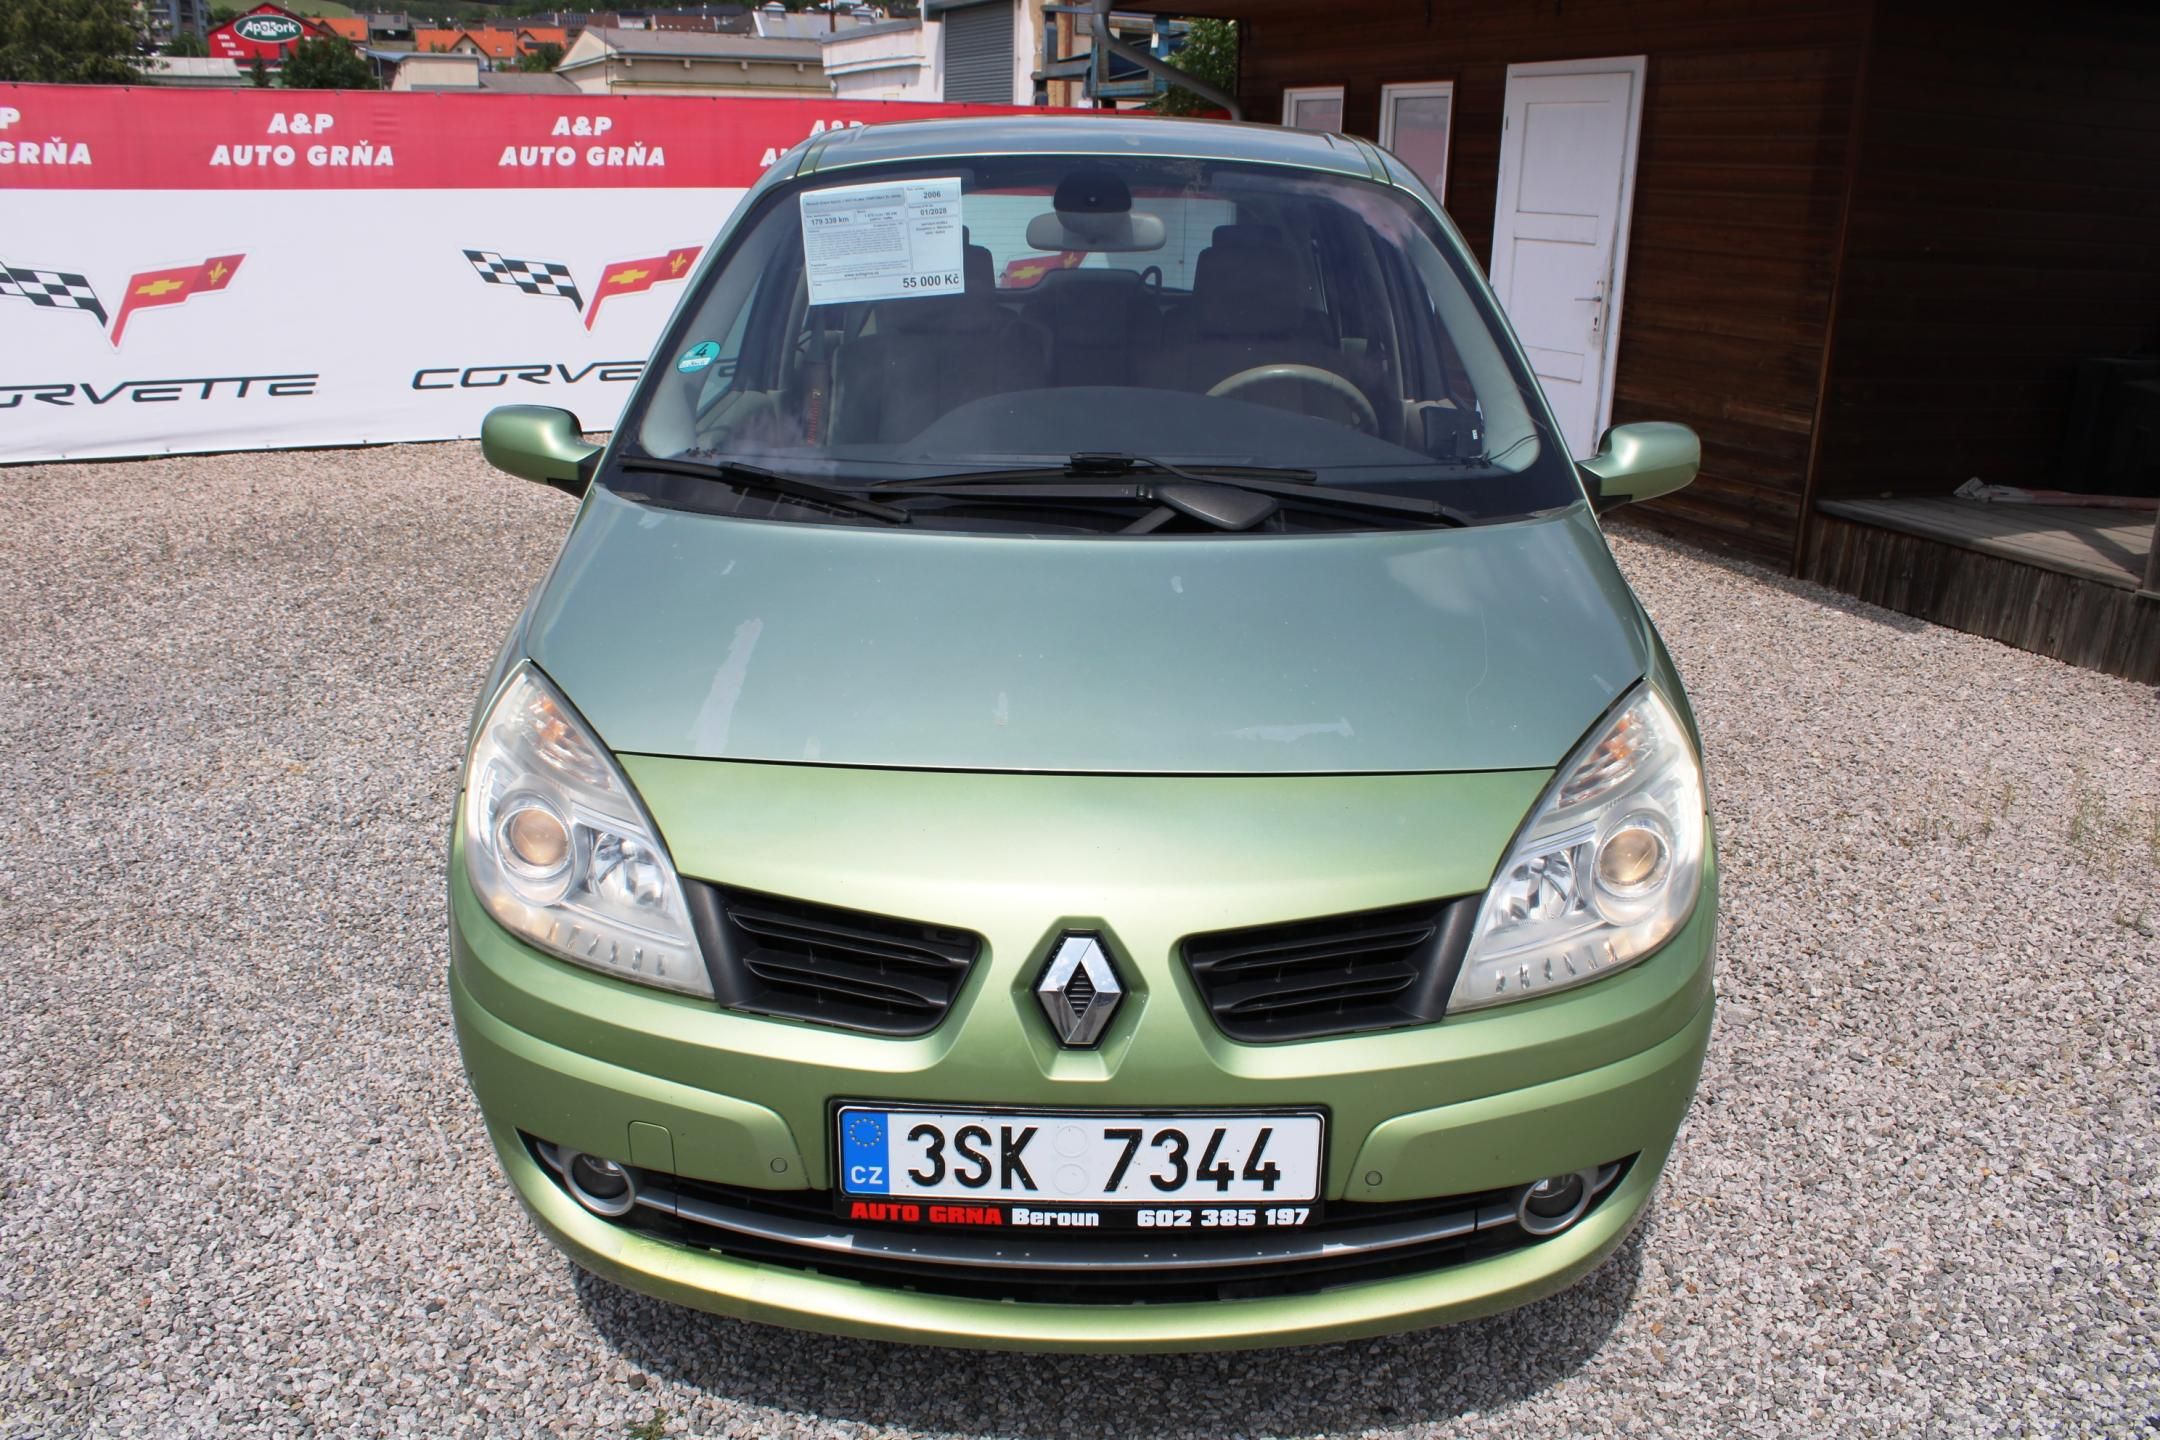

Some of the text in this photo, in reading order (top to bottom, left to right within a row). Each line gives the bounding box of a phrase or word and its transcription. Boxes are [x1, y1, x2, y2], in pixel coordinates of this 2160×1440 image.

[267, 113, 334, 134] A&P
[552, 116, 612, 136] A&P
[209, 140, 394, 166] AUTO GRŇA
[498, 141, 665, 166] AUTO GRŇA
[923, 191, 941, 199] 2006
[903, 273, 960, 288] 55 000 Kč
[695, 343, 709, 357] 4
[412, 360, 648, 390] CORVE
[907, 1124, 1282, 1193] 3SK 7344
[850, 1165, 884, 1185] CZ
[851, 1203, 919, 1222] AUTO
[1011, 1208, 1099, 1227] Beroun
[1137, 1209, 1192, 1227] 602
[1200, 1209, 1256, 1227] 385
[1265, 1208, 1310, 1226] 197
